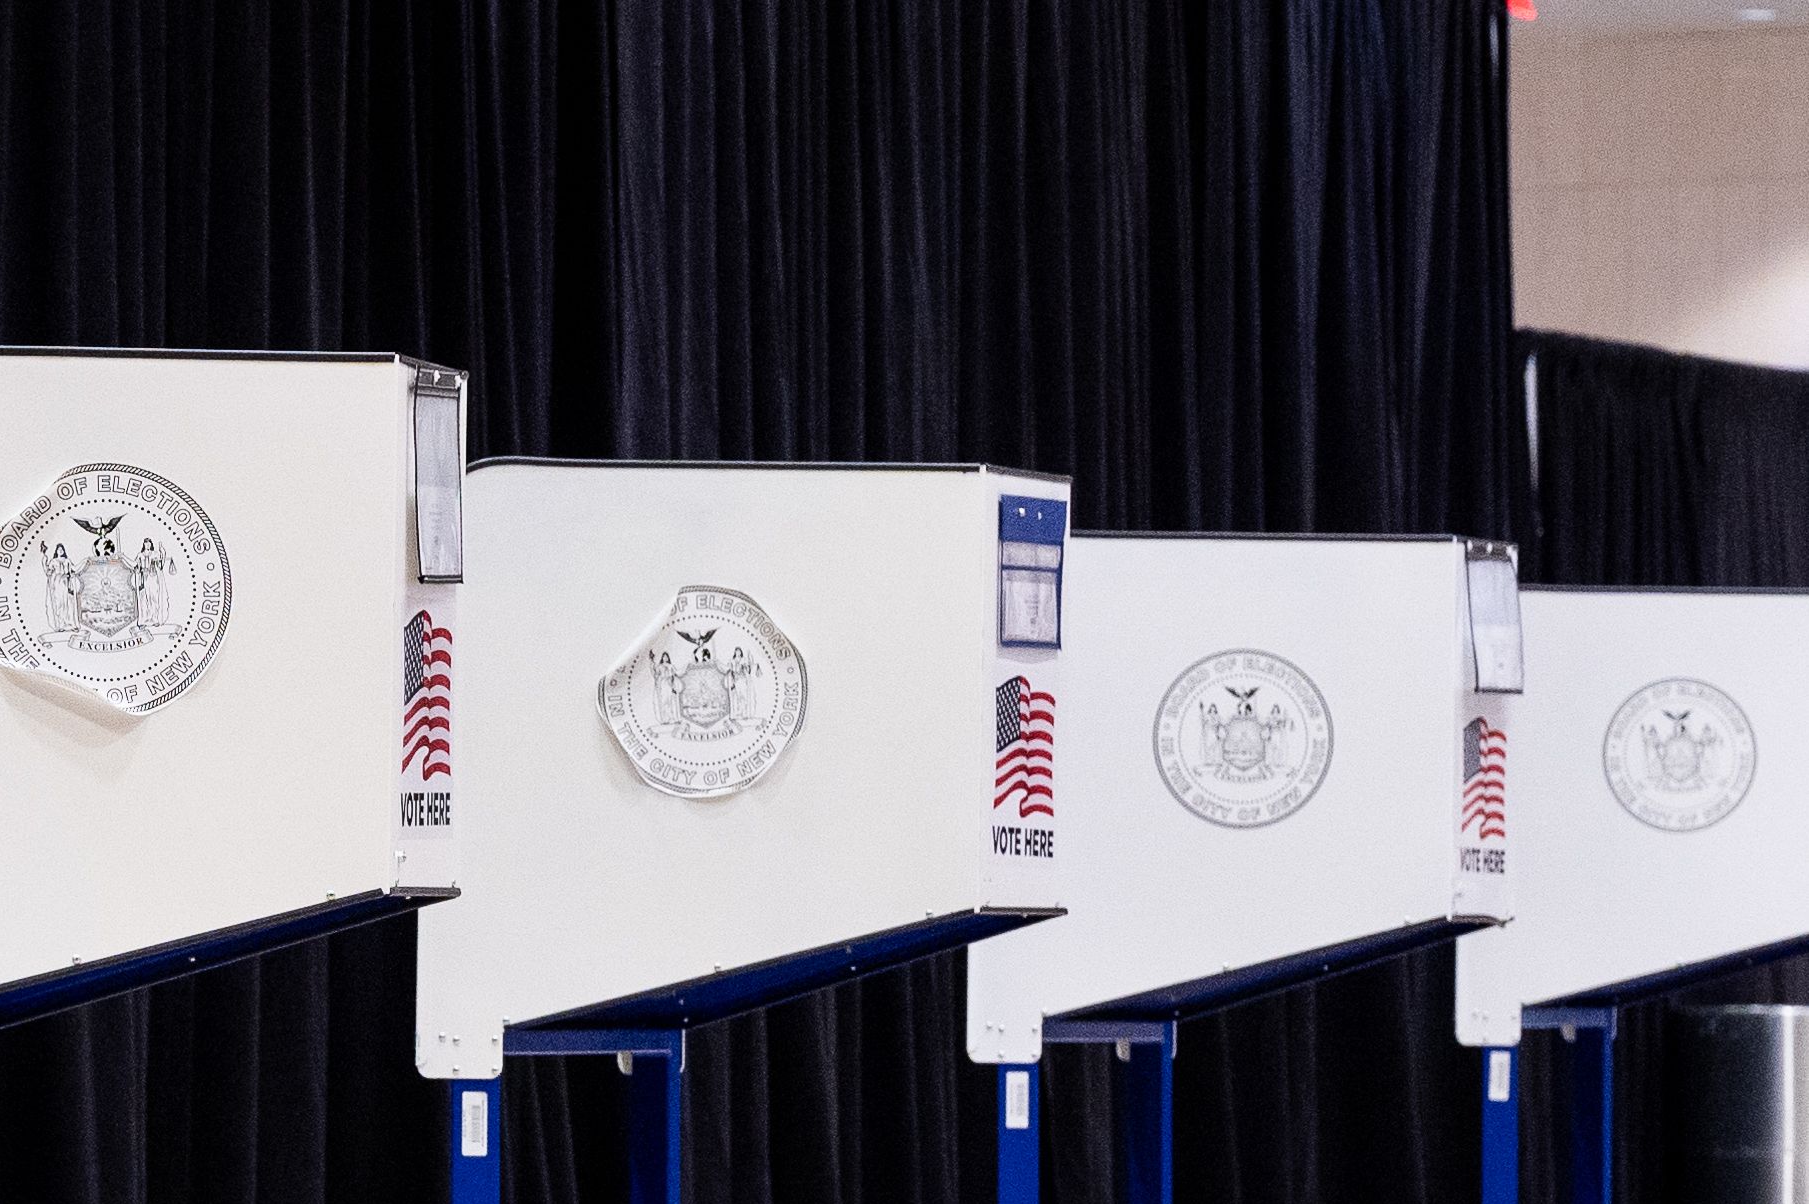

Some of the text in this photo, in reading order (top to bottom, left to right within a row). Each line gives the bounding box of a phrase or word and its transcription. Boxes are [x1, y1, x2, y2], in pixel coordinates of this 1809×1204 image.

[57, 477, 88, 500] OF
[98, 475, 211, 555] ELECTIONS
[79, 638, 144, 650] EXCELSIOR
[106, 685, 139, 705] OF
[146, 651, 194, 696] NEW
[188, 581, 221, 648] YORK
[696, 595, 791, 660] ELECTIONS
[608, 682, 799, 786] IN THE CITY OF NEW YORK
[400, 792, 450, 827] VOTE HERE
[992, 825, 1054, 858] VOTE HERE
